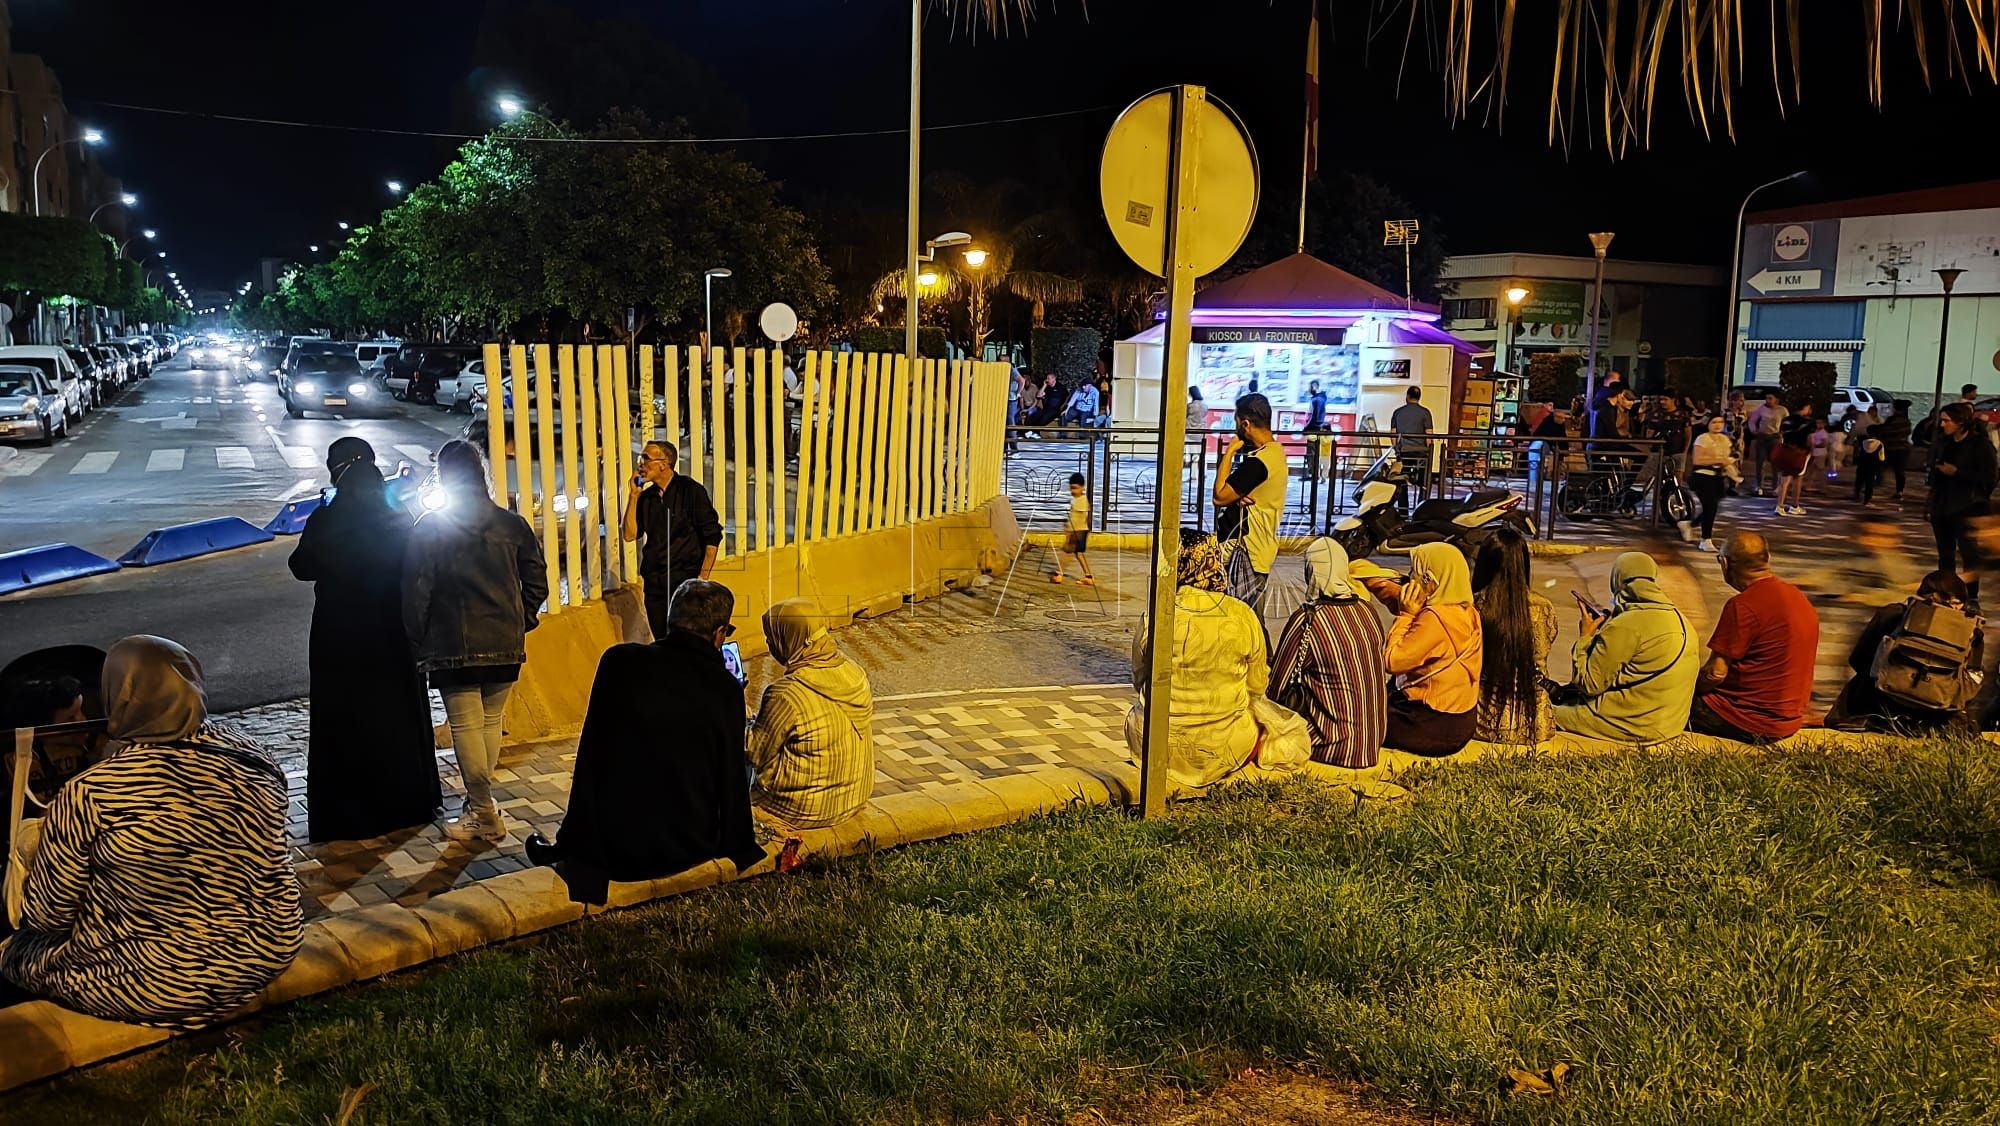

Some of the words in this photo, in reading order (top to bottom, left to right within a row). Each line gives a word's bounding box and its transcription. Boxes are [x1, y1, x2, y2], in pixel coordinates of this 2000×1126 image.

[1775, 276, 1782, 285] 4
[1784, 275, 1801, 285] KM
[1208, 331, 1243, 342] KIOSCO
[1249, 331, 1261, 342] LA
[1265, 331, 1315, 343] FRONTERA
